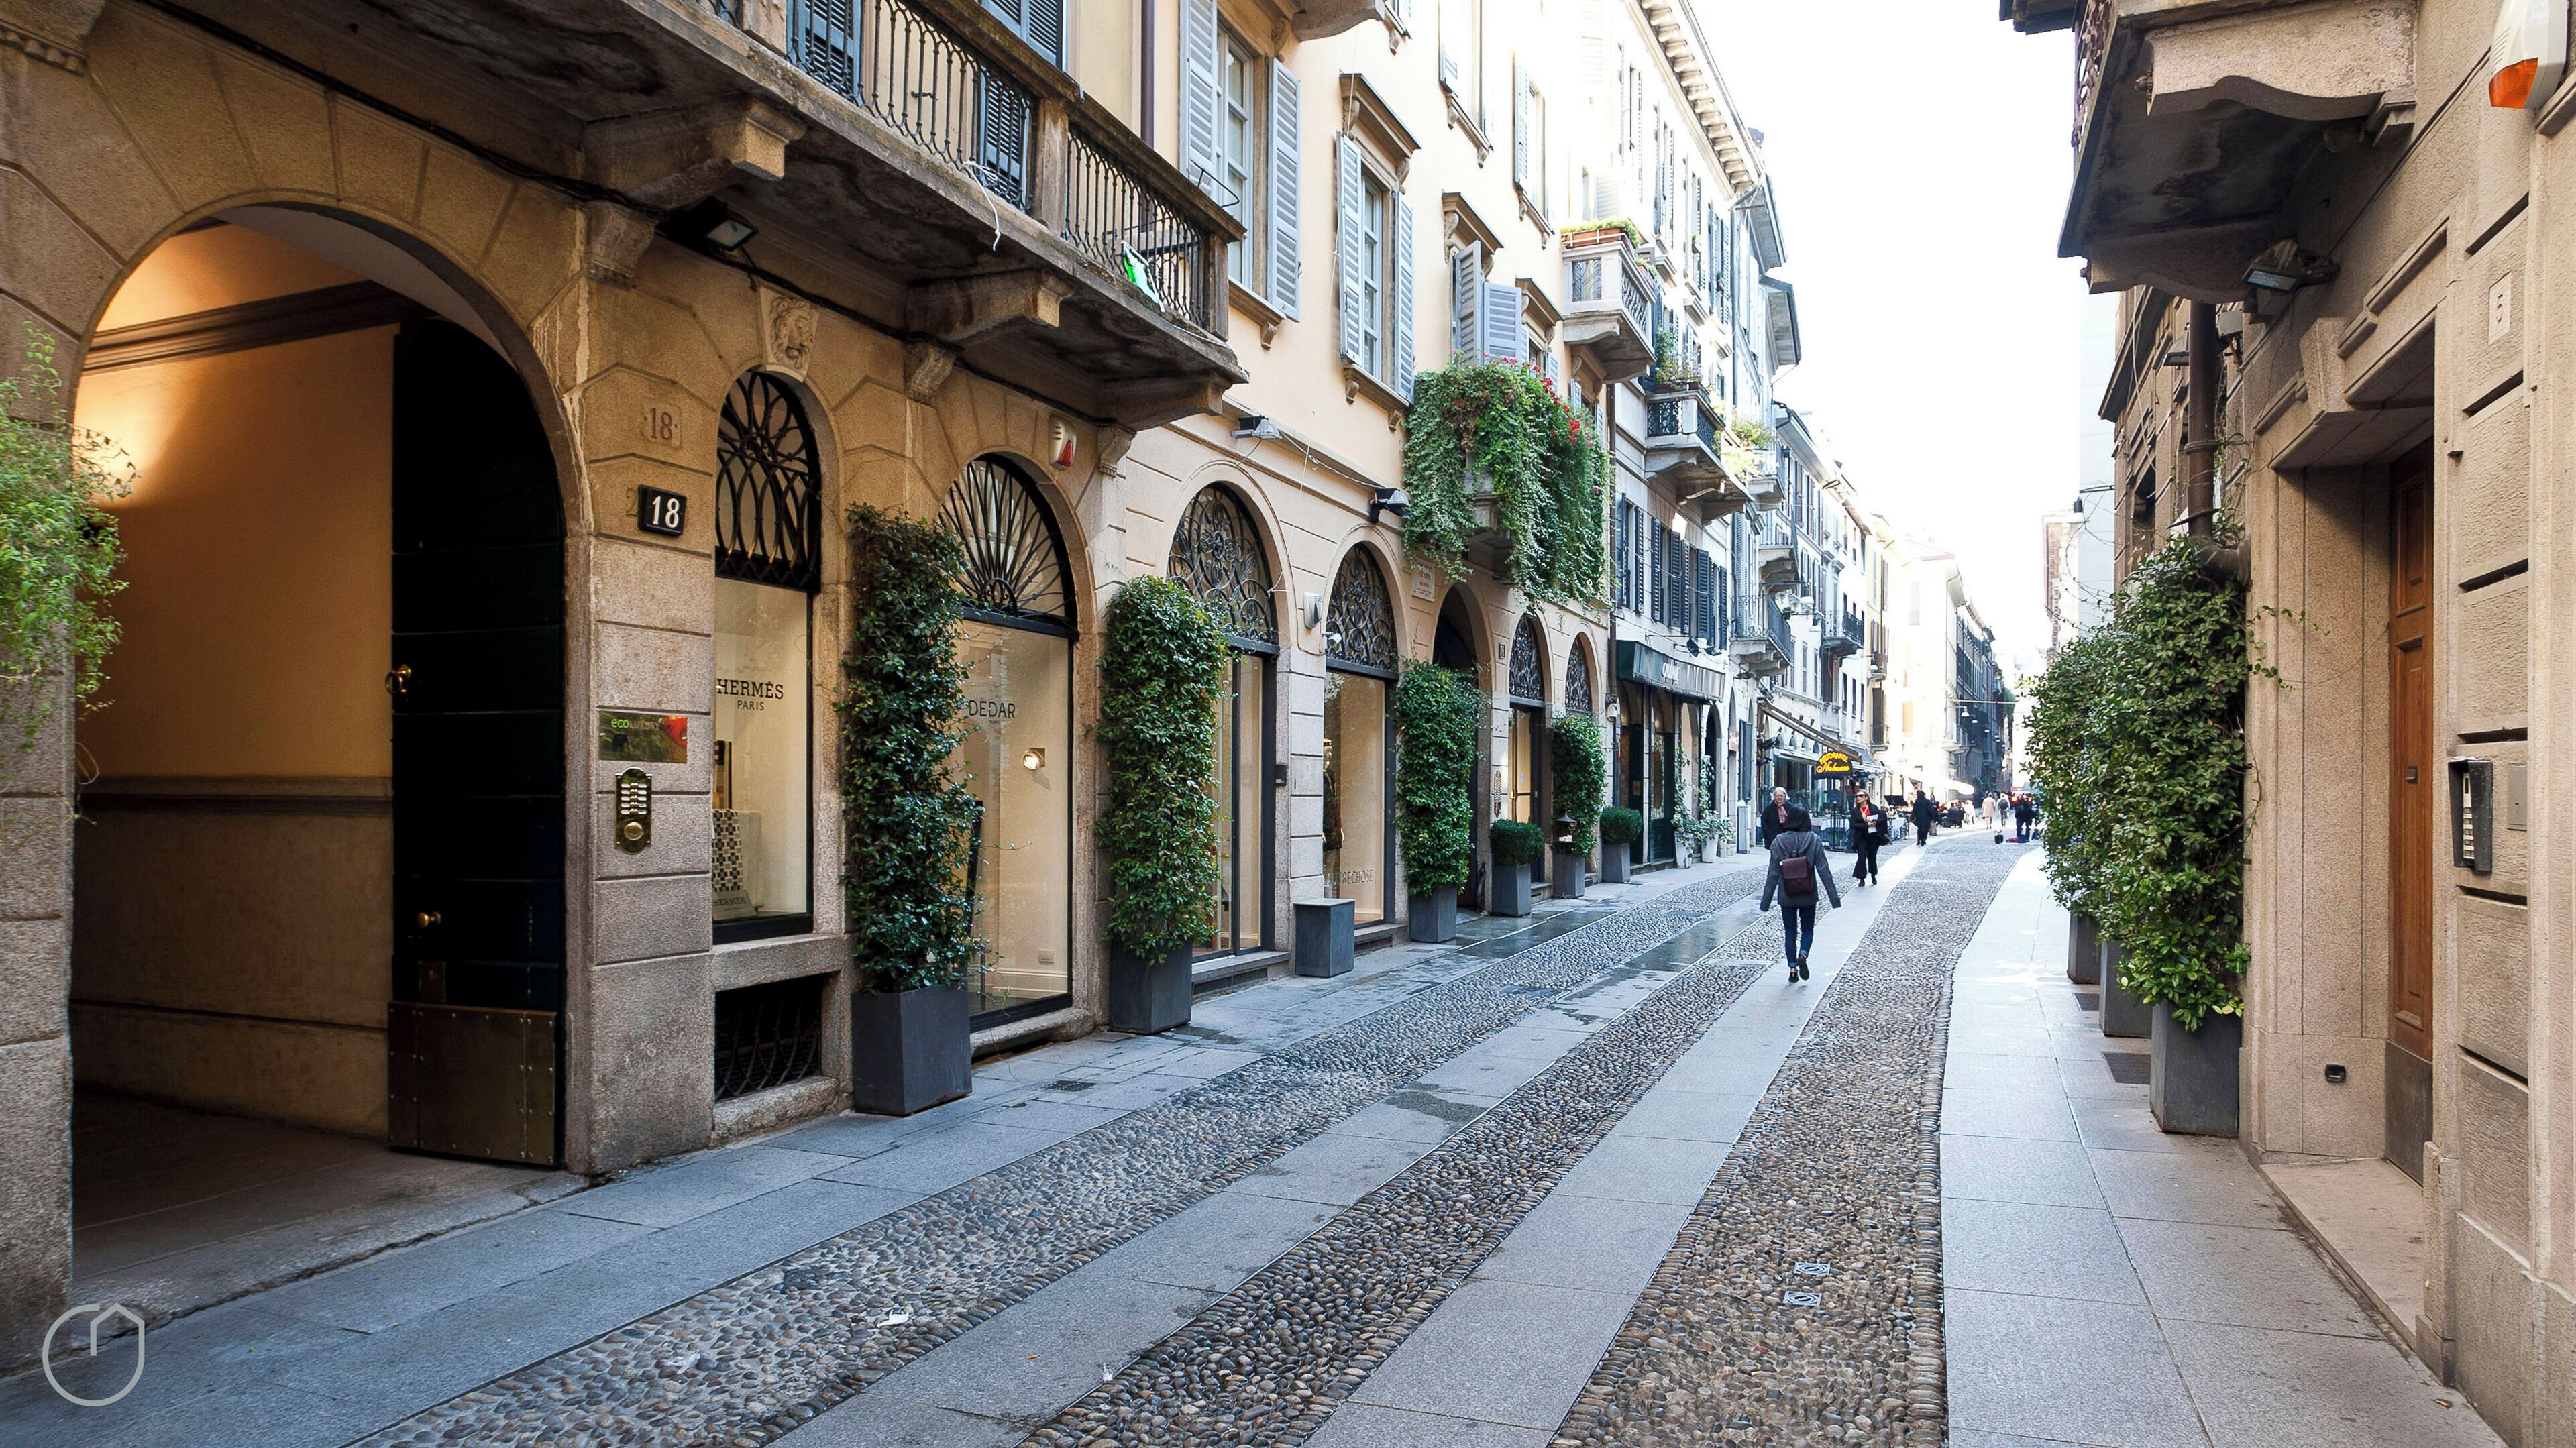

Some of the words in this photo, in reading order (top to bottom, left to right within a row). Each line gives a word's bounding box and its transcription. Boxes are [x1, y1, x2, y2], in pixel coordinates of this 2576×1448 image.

[2496, 294, 2503, 323] 5
[649, 407, 673, 441] 18
[652, 495, 680, 528] 18
[716, 678, 784, 700] HERMÈS
[737, 700, 765, 711] PARIS
[969, 700, 1016, 719] DEDAR
